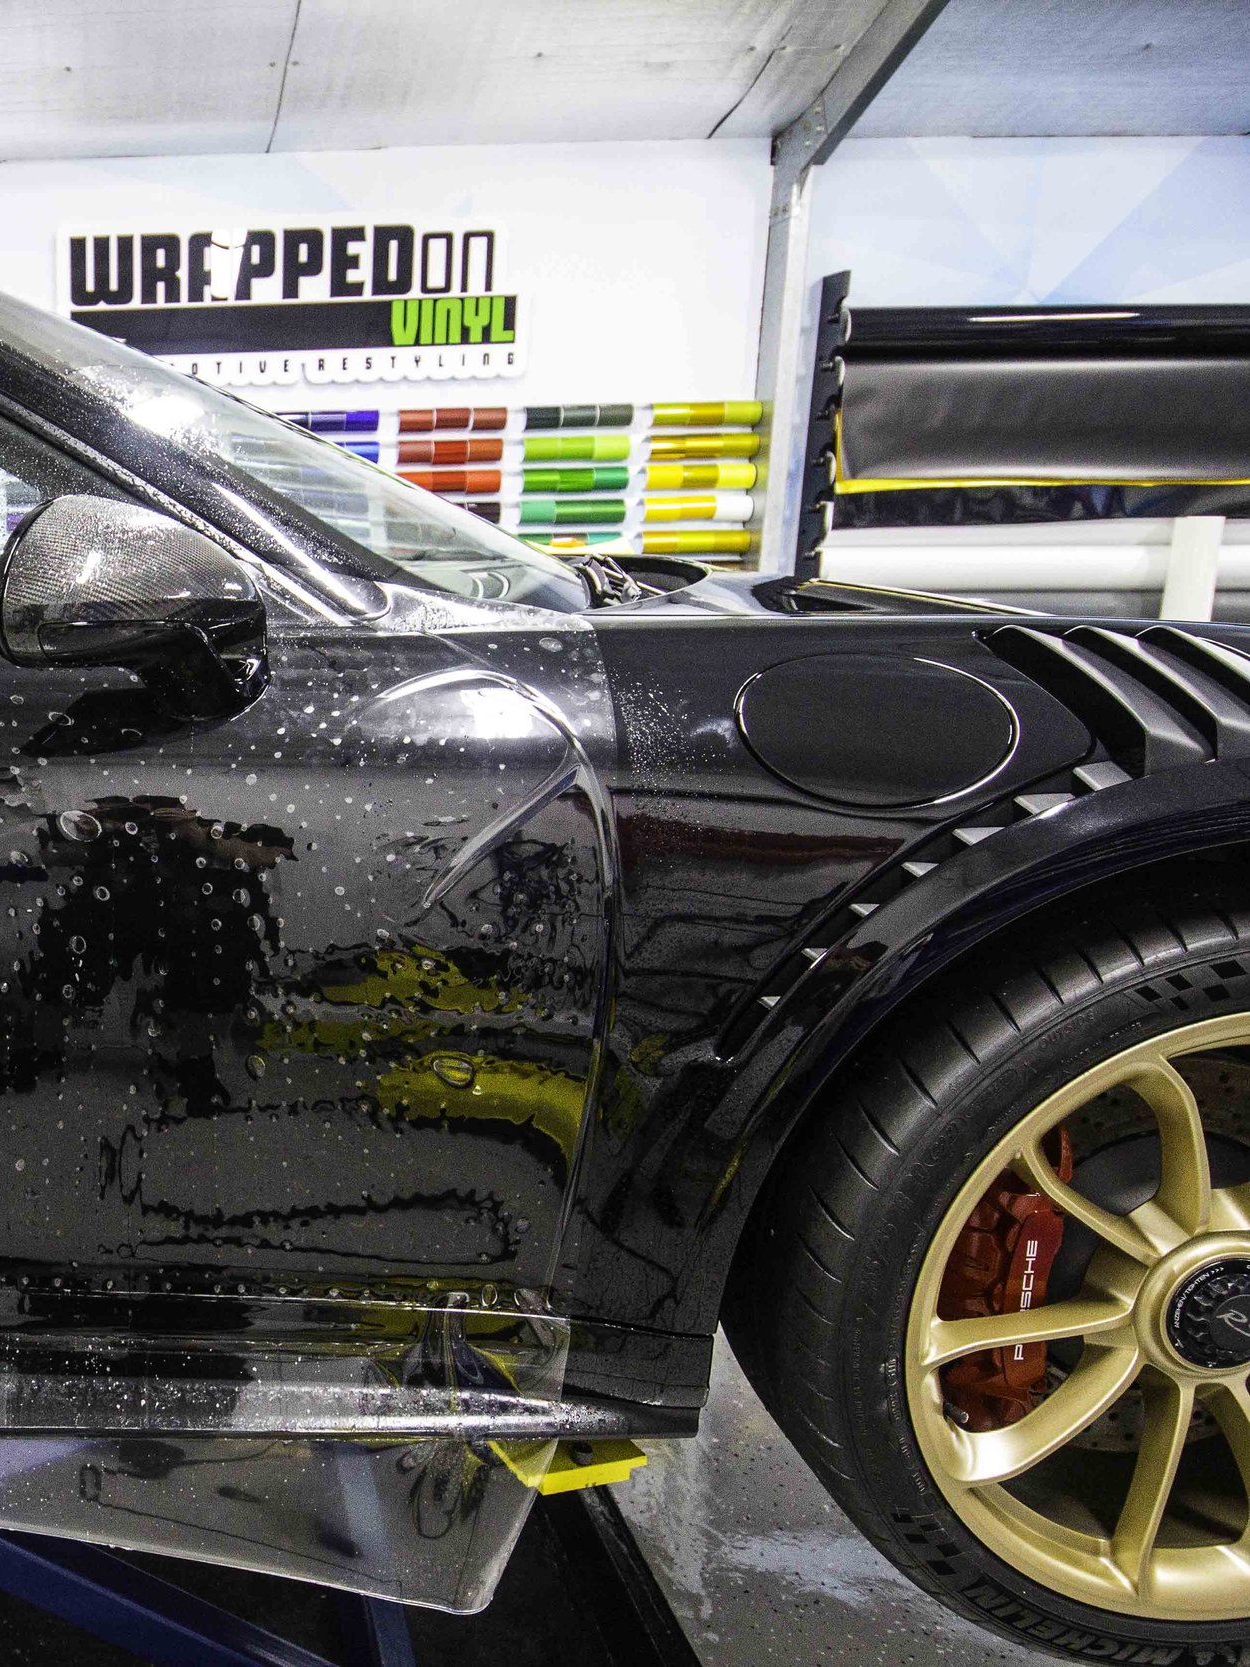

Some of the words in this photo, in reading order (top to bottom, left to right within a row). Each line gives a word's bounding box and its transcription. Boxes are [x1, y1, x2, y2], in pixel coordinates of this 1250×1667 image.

[391, 296, 515, 346] VINYL
[188, 359, 290, 376] OTIVE
[317, 353, 514, 372] RESTYLING
[1014, 1240, 1038, 1360] PSCHE
[962, 1582, 1184, 1666] MICHELIN
